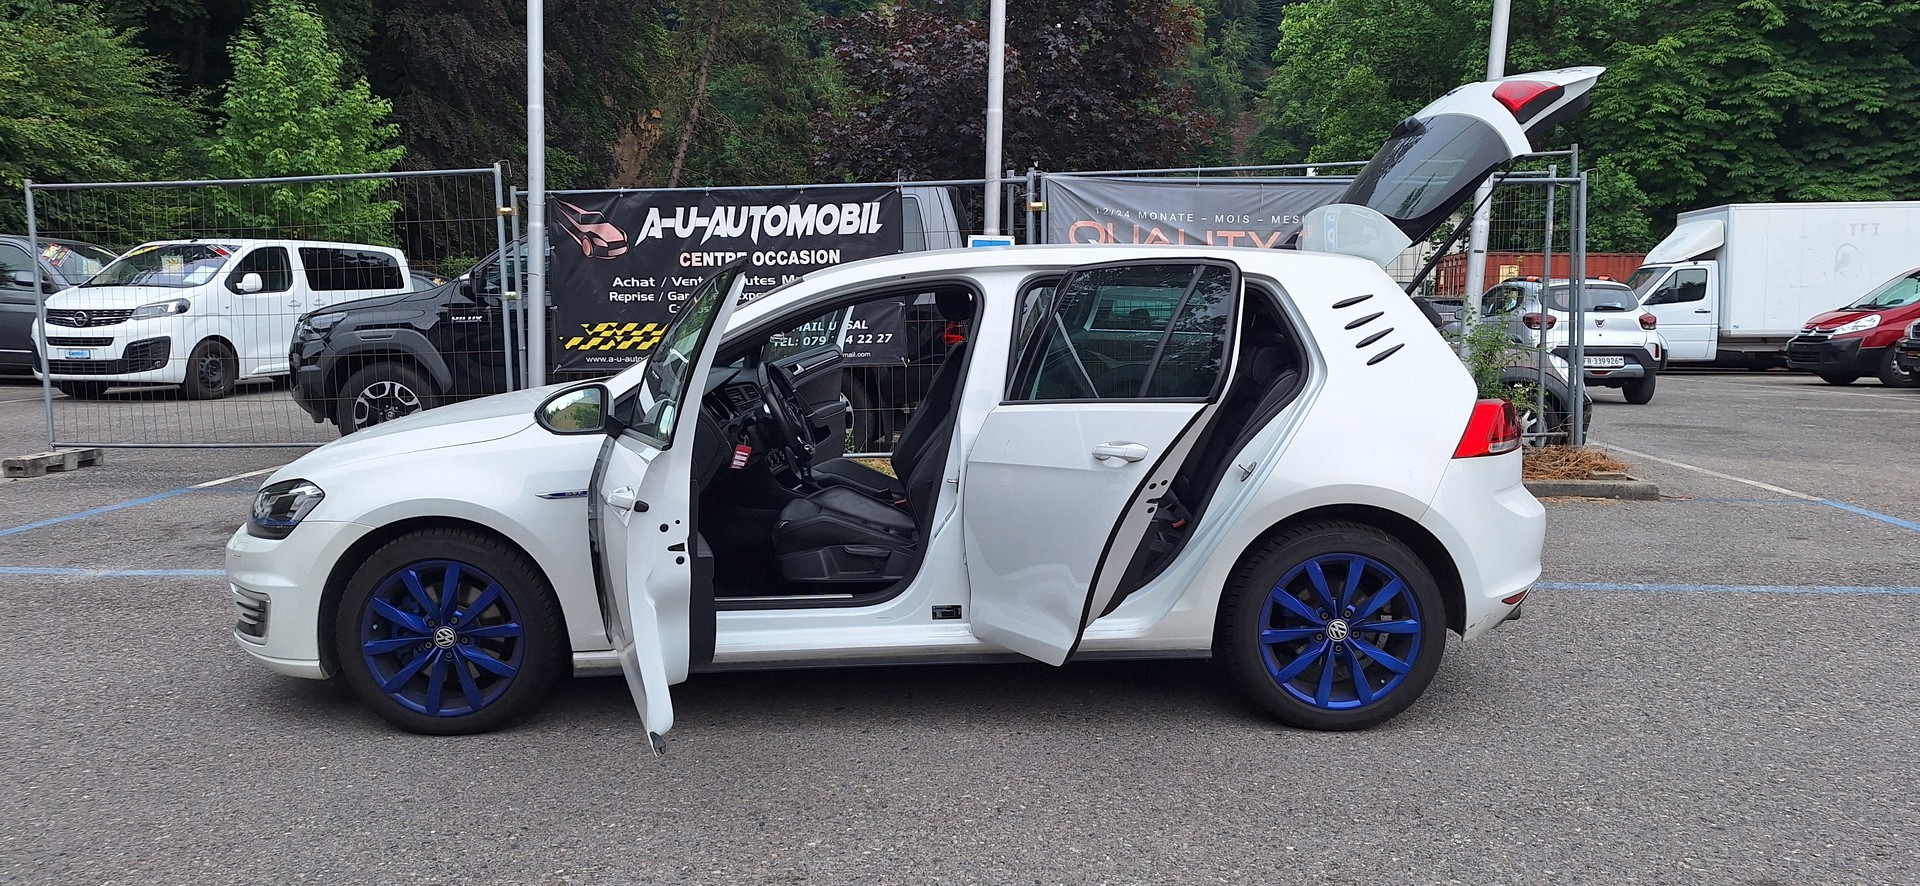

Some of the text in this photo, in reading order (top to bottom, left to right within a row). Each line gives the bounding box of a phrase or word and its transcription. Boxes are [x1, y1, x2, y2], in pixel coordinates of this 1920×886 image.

[1095, 207, 1130, 218] 12/24
[1138, 211, 1194, 222] MONATE
[1215, 214, 1250, 224] MOIS
[635, 201, 883, 247] A-U-AUTOMOBIL
[752, 249, 841, 266] OCCASION
[612, 276, 656, 287] Achat
[671, 276, 704, 287] Vent
[745, 275, 776, 286] utes
[609, 291, 655, 302] Reprise
[828, 320, 869, 332] USAL
[803, 336, 827, 346] 079
[857, 334, 873, 344] 22
[876, 333, 893, 343] 27
[585, 350, 872, 363] www.a-u-auto mail.com
